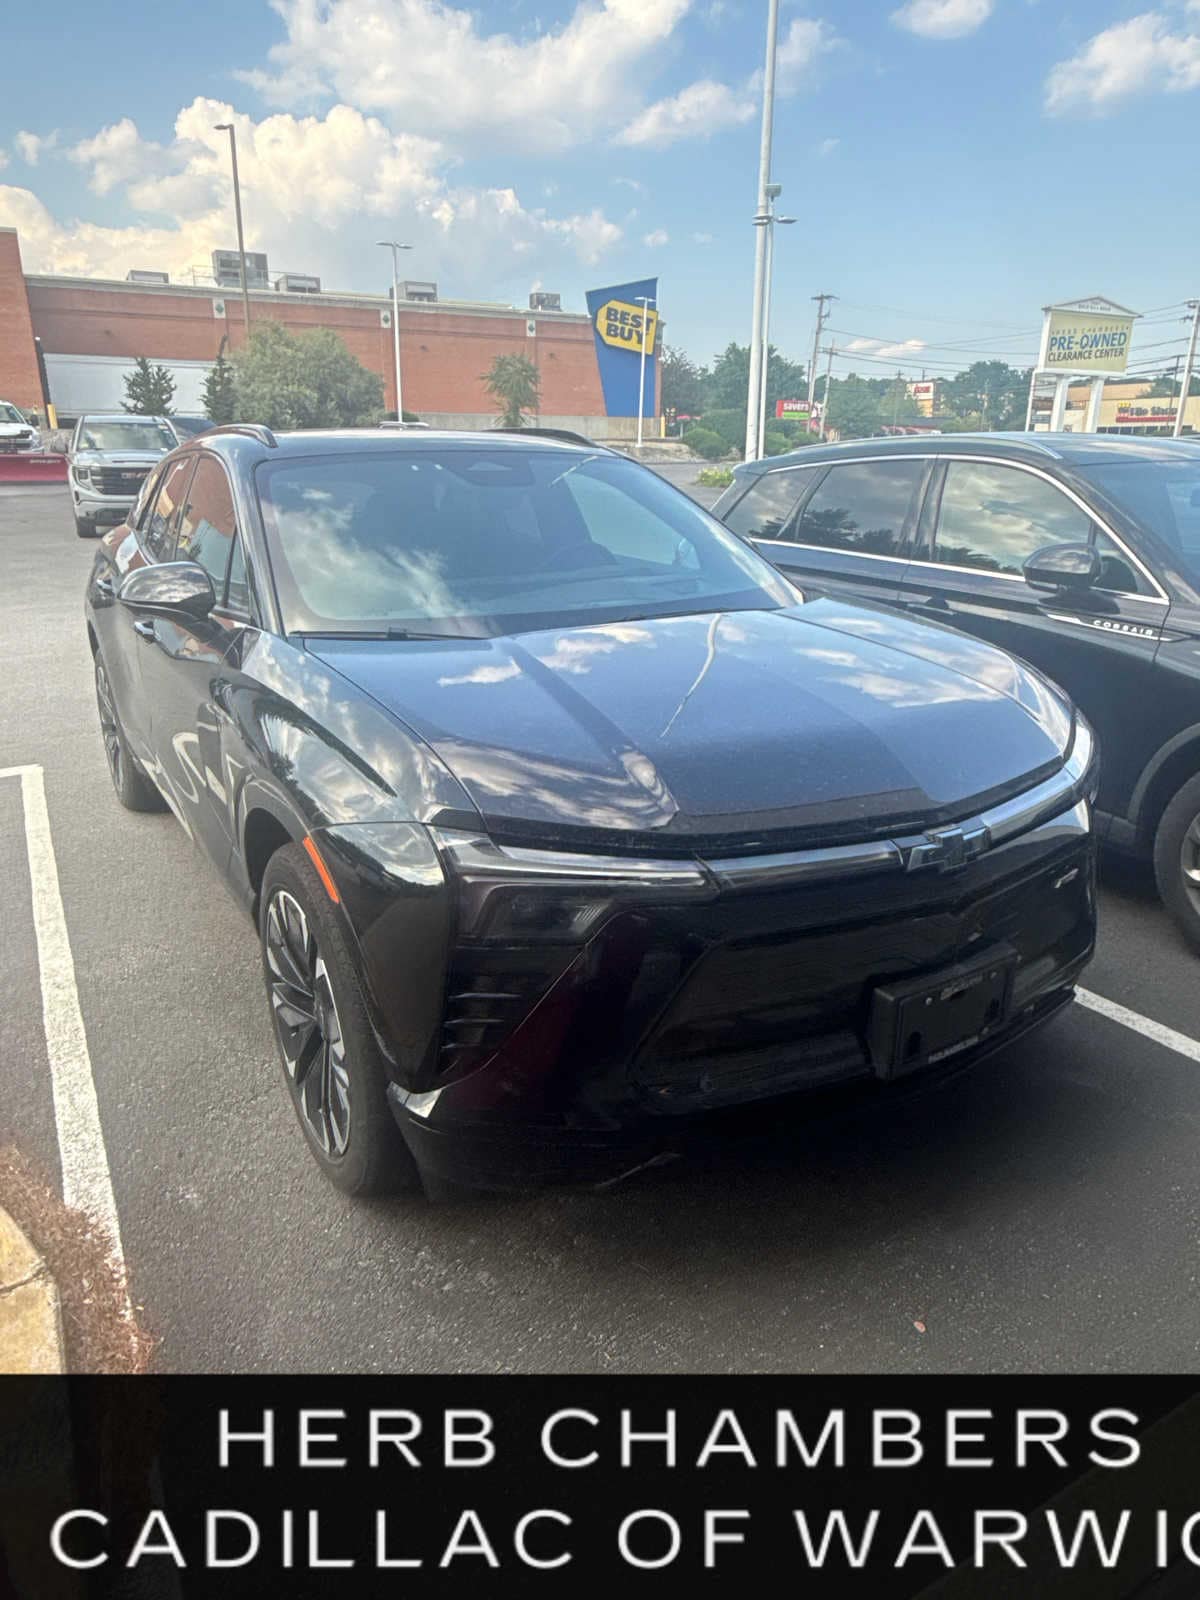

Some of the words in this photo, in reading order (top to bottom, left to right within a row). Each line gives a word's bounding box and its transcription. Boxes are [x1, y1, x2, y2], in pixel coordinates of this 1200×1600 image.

[606, 306, 655, 336] BEST
[606, 322, 650, 345] BUY
[1049, 332, 1127, 351] PRE-OWNED
[1047, 350, 1093, 362] CLEARANCE
[1094, 347, 1125, 359] CENTER
